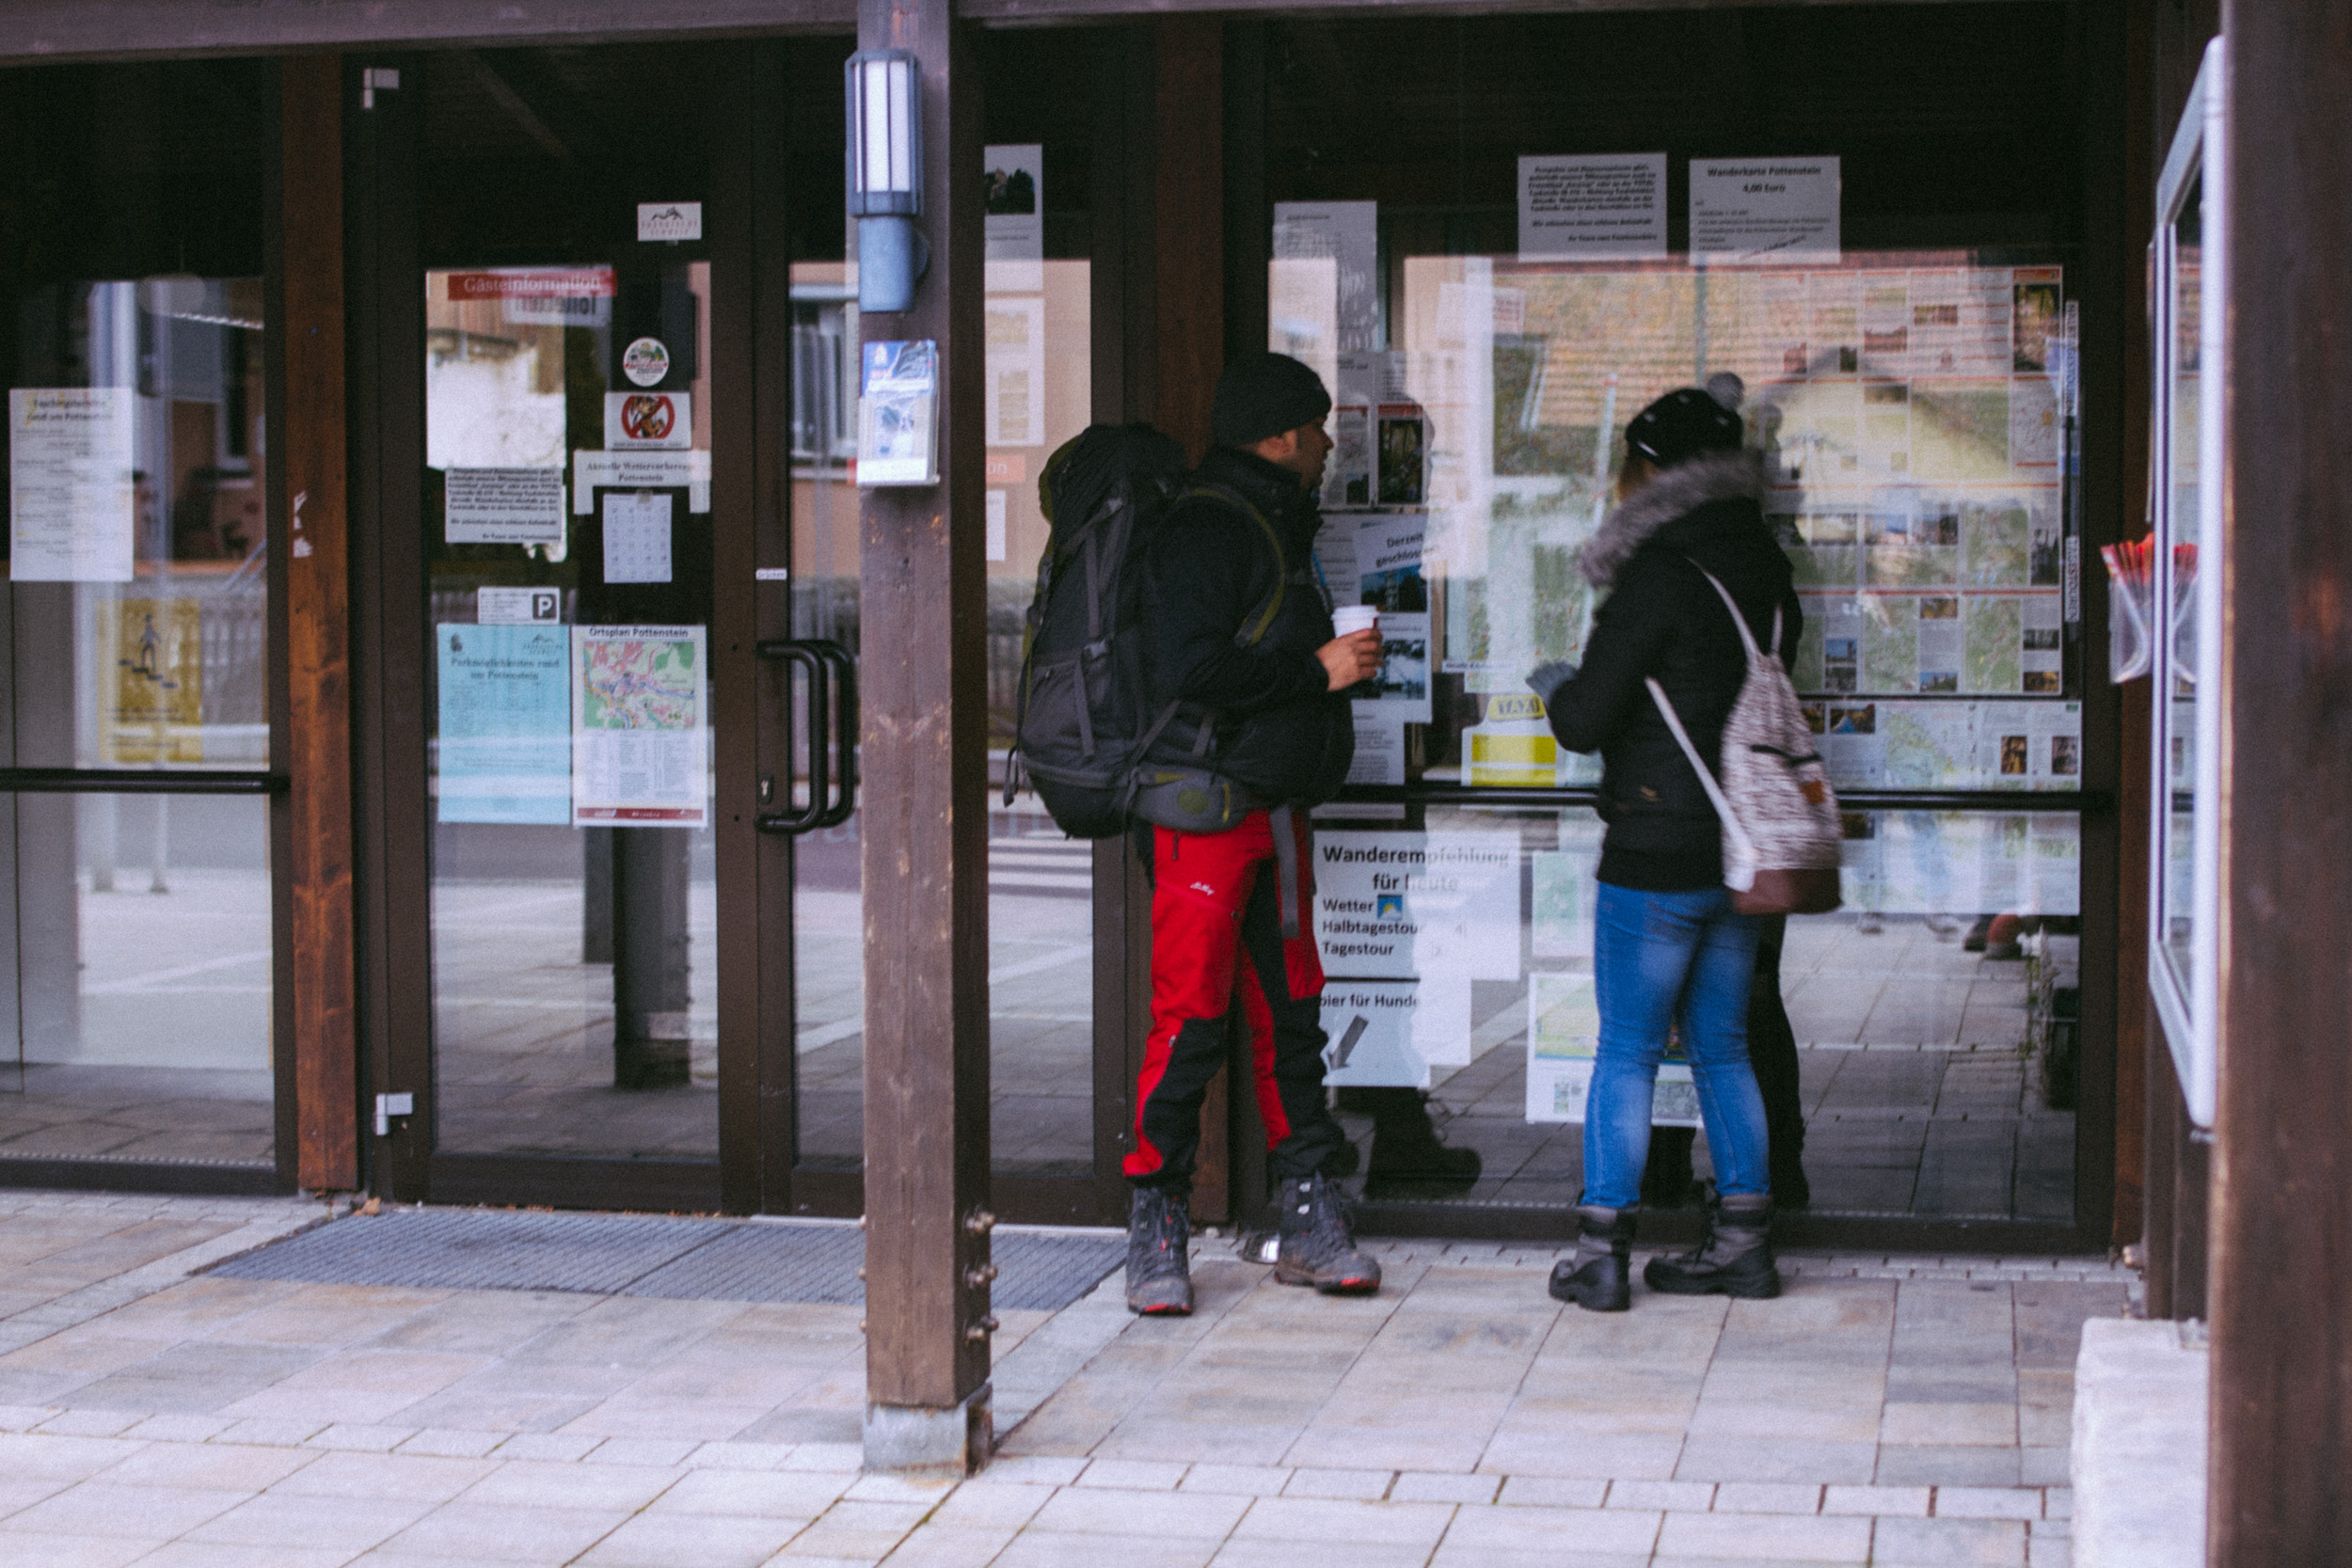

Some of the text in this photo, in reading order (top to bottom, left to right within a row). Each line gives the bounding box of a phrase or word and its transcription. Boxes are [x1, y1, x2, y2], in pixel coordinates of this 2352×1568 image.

[1708, 166, 1821, 177] Wanderkarte Pottenstein
[1764, 183, 1786, 193] Euro
[464, 275, 601, 293] Gästeinformation
[587, 461, 621, 470] Aktuelle
[618, 473, 664, 482] Pottenstein
[1387, 532, 1422, 547] Derzeit
[538, 596, 552, 616] P
[589, 626, 689, 639] Ortsplan Pottenstein
[537, 659, 560, 668] rund
[1323, 846, 1509, 867] Wanderempfehlung
[1374, 873, 1459, 892] für heute
[1323, 898, 1374, 911] Wetter
[1323, 942, 1395, 958] Tagestour
[1350, 994, 1370, 1007] für
